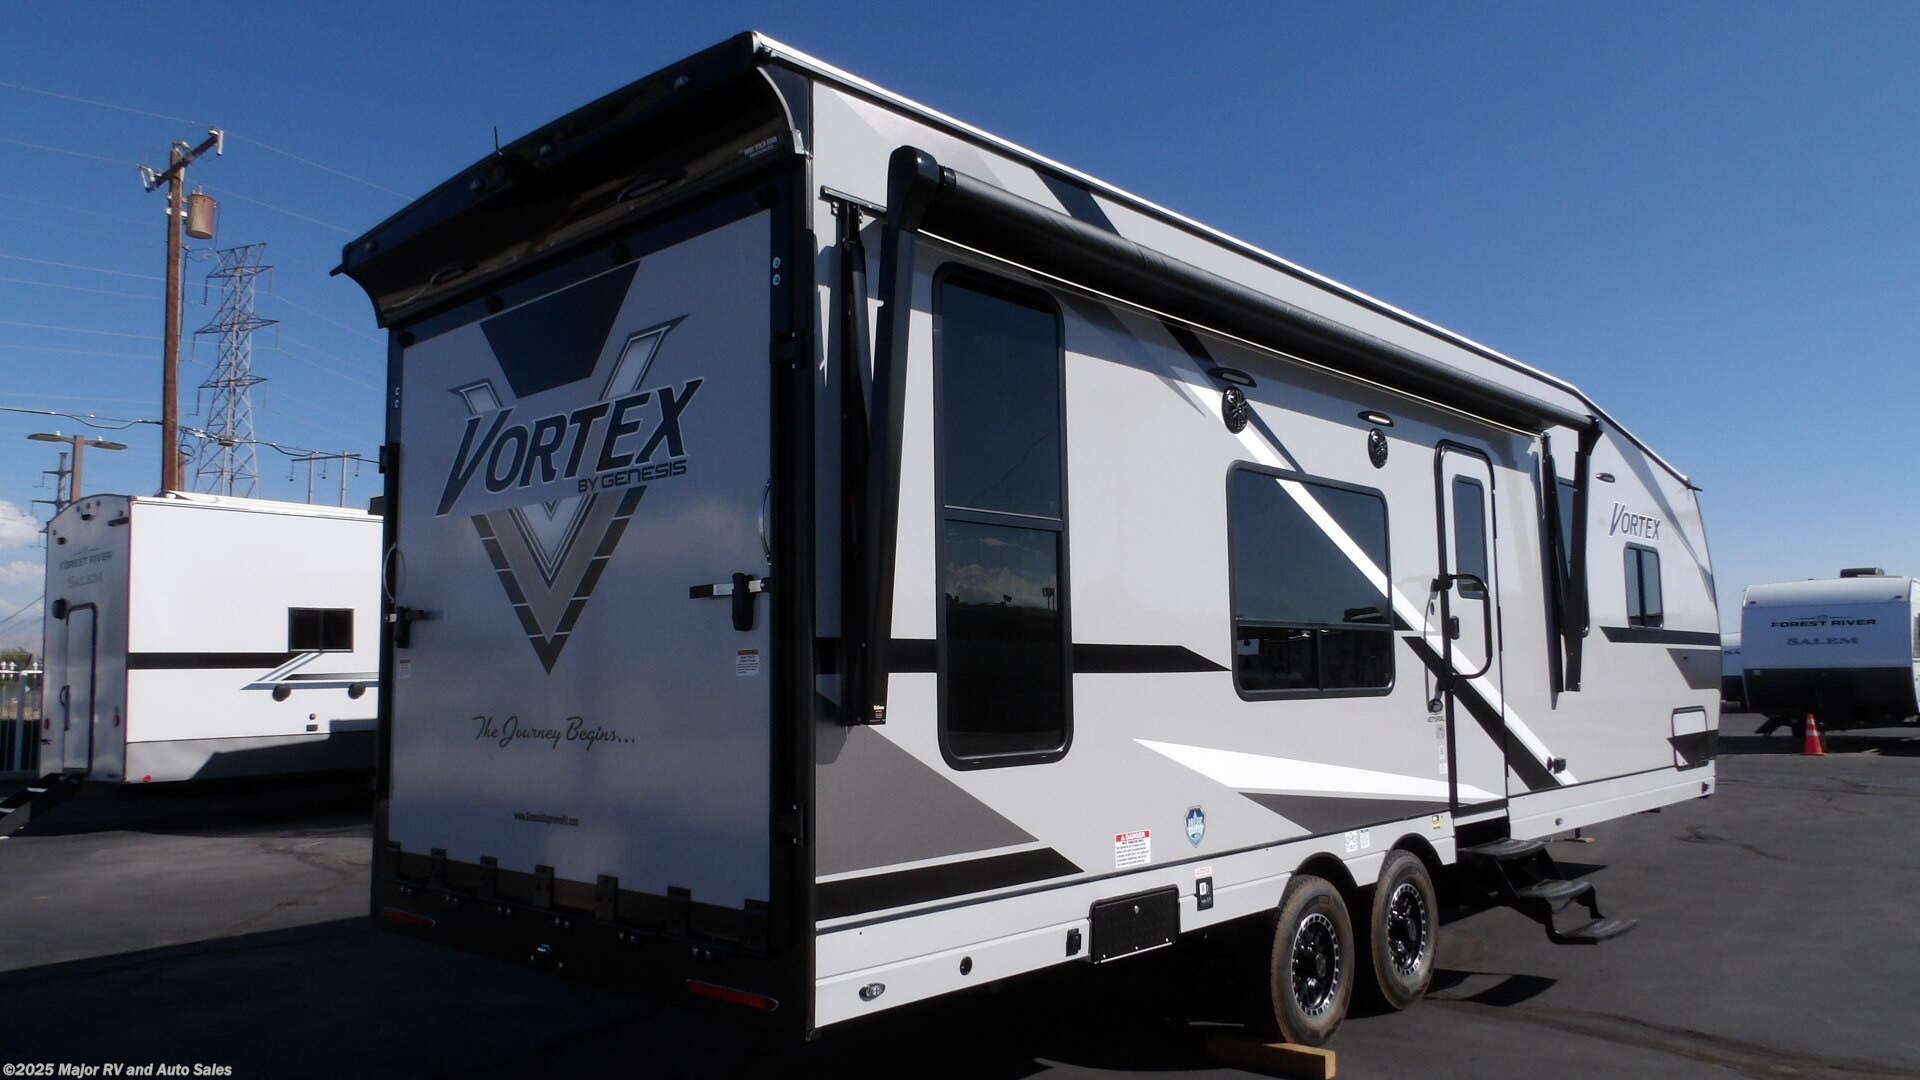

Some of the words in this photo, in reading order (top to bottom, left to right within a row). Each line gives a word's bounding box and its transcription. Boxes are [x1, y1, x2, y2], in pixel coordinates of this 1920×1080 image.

[435, 377, 704, 517] VORTEX
[578, 478, 598, 493] BY
[601, 460, 688, 489] GENESIS
[1608, 502, 1661, 540] VORTEX
[1770, 620, 1828, 628] FOREST
[1786, 637, 1859, 646] SALEM
[472, 716, 498, 740] The
[499, 715, 562, 749] Journey
[566, 716, 636, 751] Begins...
